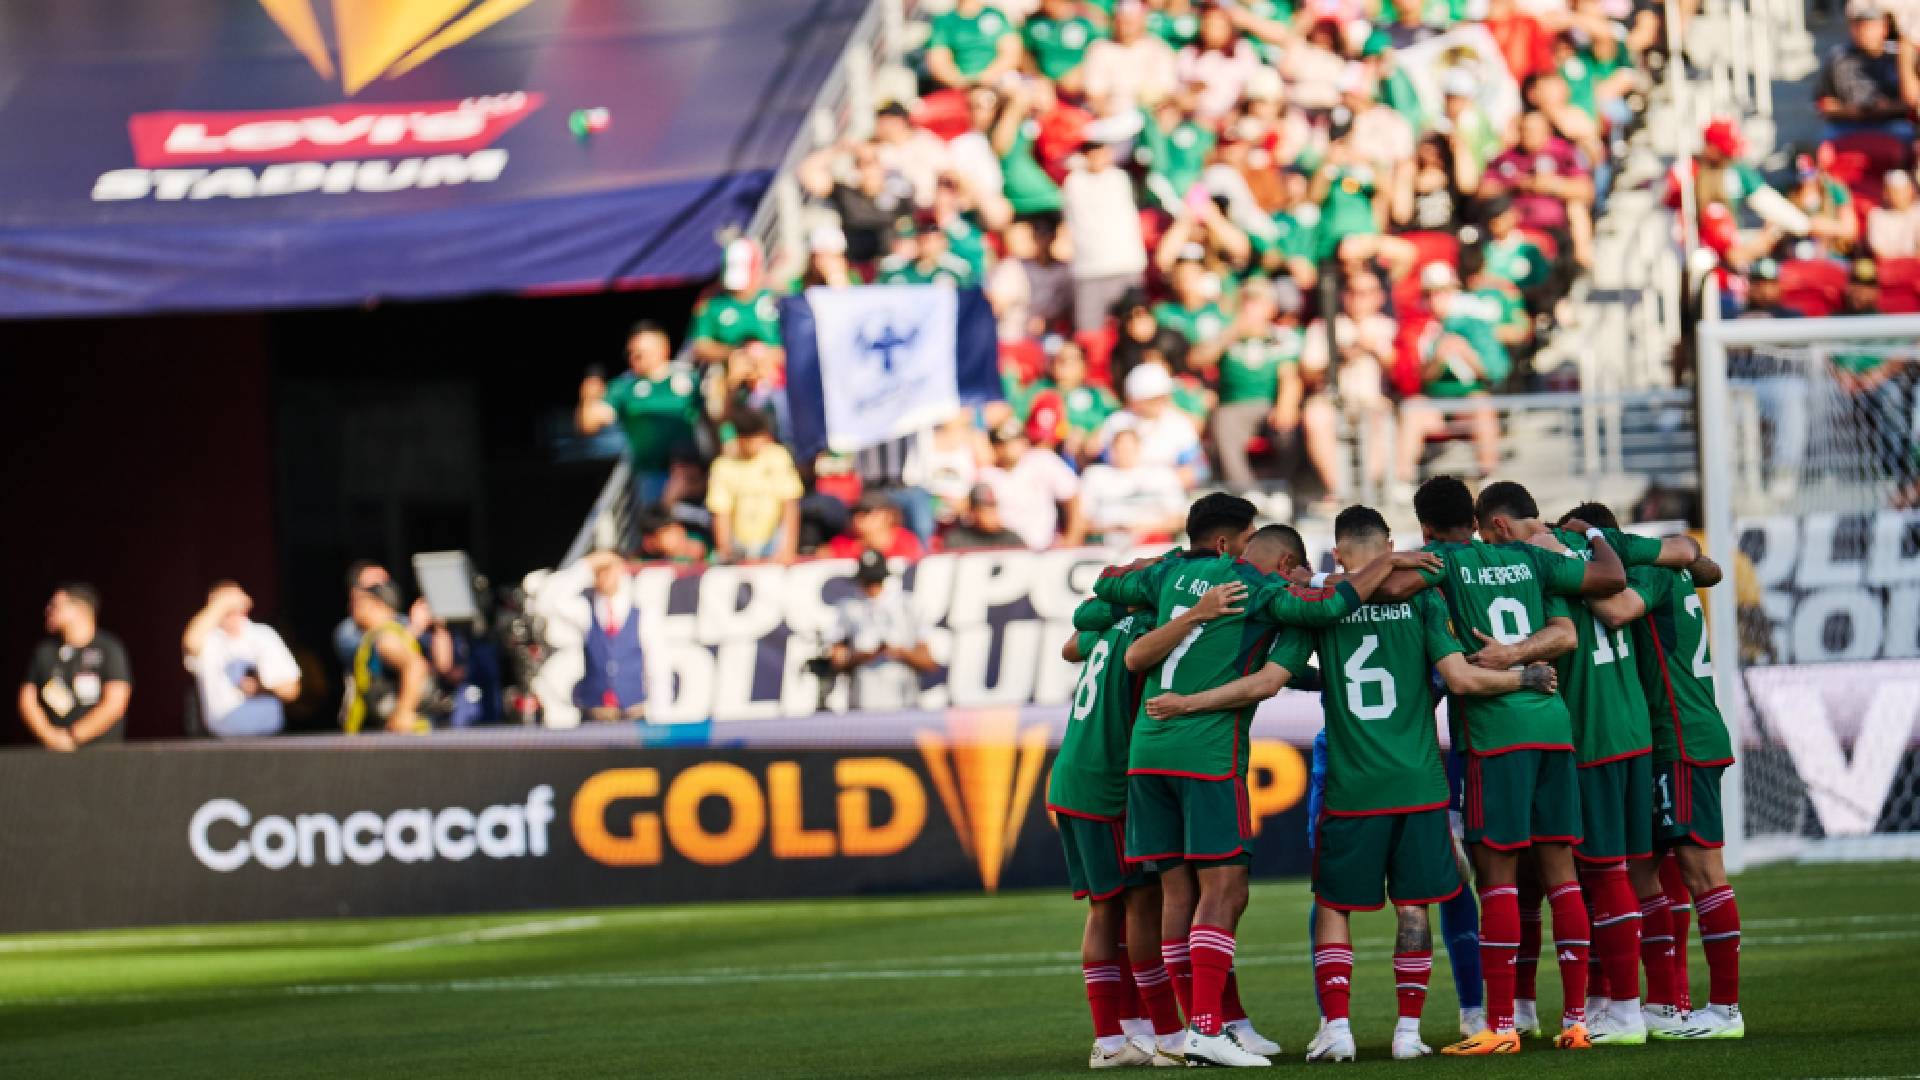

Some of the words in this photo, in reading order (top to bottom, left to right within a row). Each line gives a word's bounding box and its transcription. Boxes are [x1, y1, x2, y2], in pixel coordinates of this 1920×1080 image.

[92, 149, 508, 200] STADIUM
[1074, 639, 1108, 721] 8
[1161, 605, 1207, 690] 7
[1344, 634, 1398, 720] 6
[189, 784, 554, 871] Concacaf
[570, 756, 928, 866] GOLD
